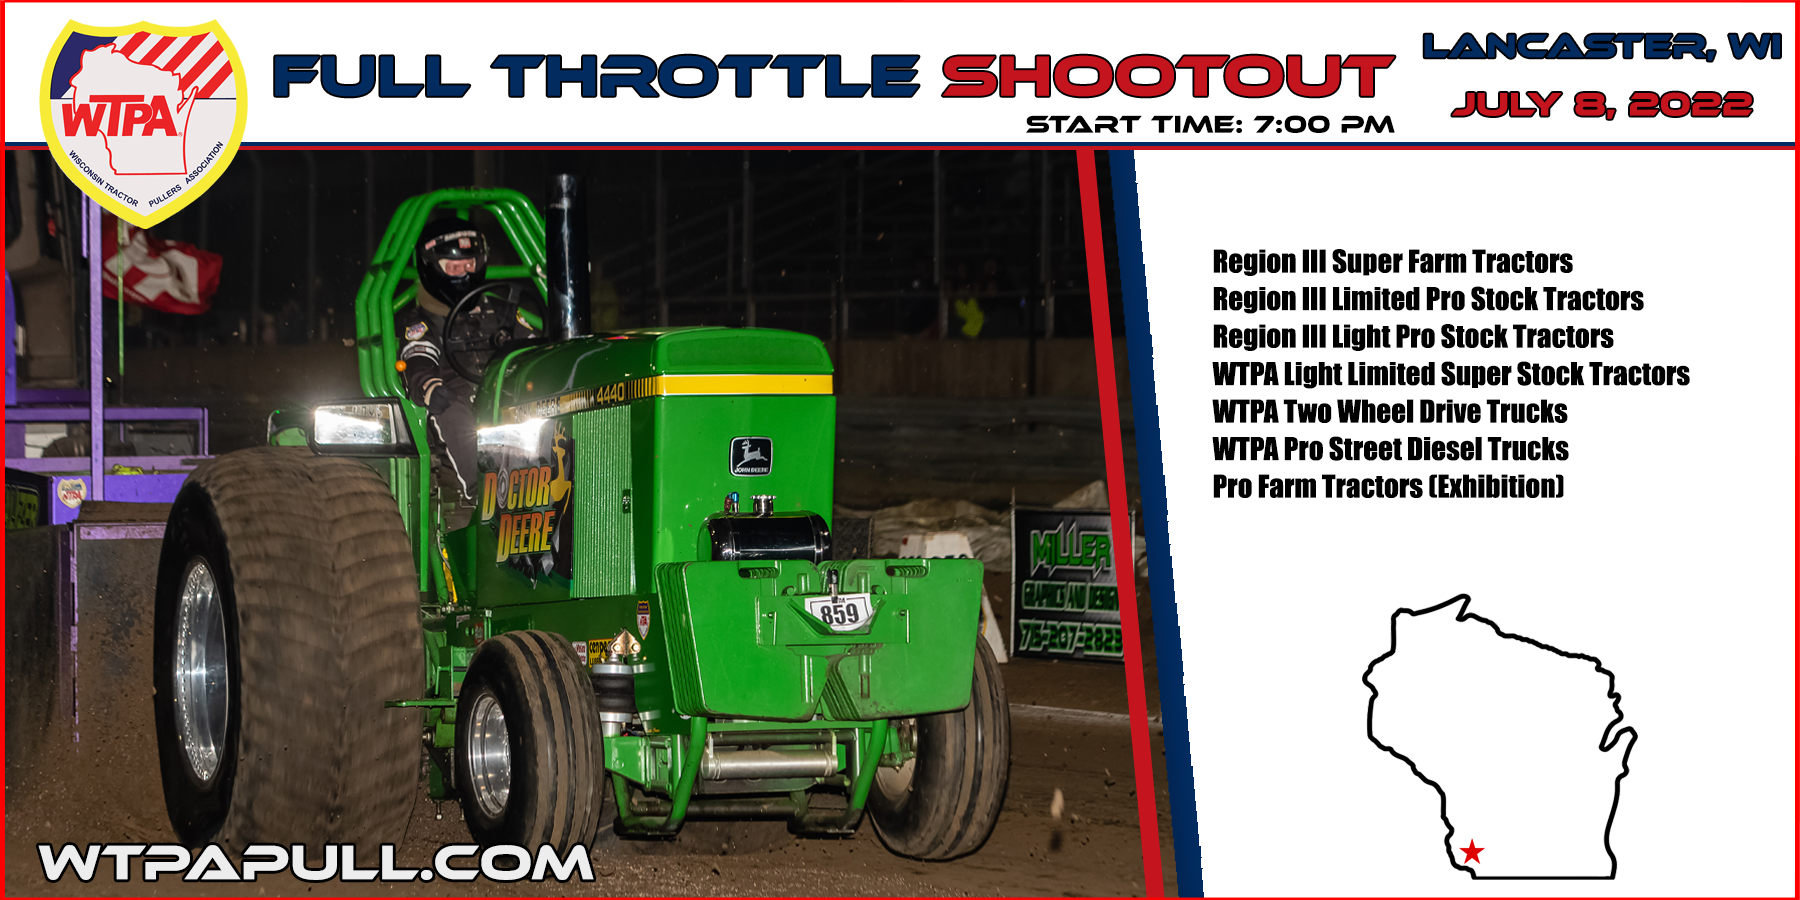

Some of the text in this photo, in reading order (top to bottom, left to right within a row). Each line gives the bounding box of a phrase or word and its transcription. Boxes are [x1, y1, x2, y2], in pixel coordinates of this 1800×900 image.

[597, 382, 625, 405] 4440
[481, 465, 552, 525] DOCTOR
[496, 511, 556, 564] DEERE
[1030, 521, 1113, 578] MILLER
[820, 603, 859, 625] 859
